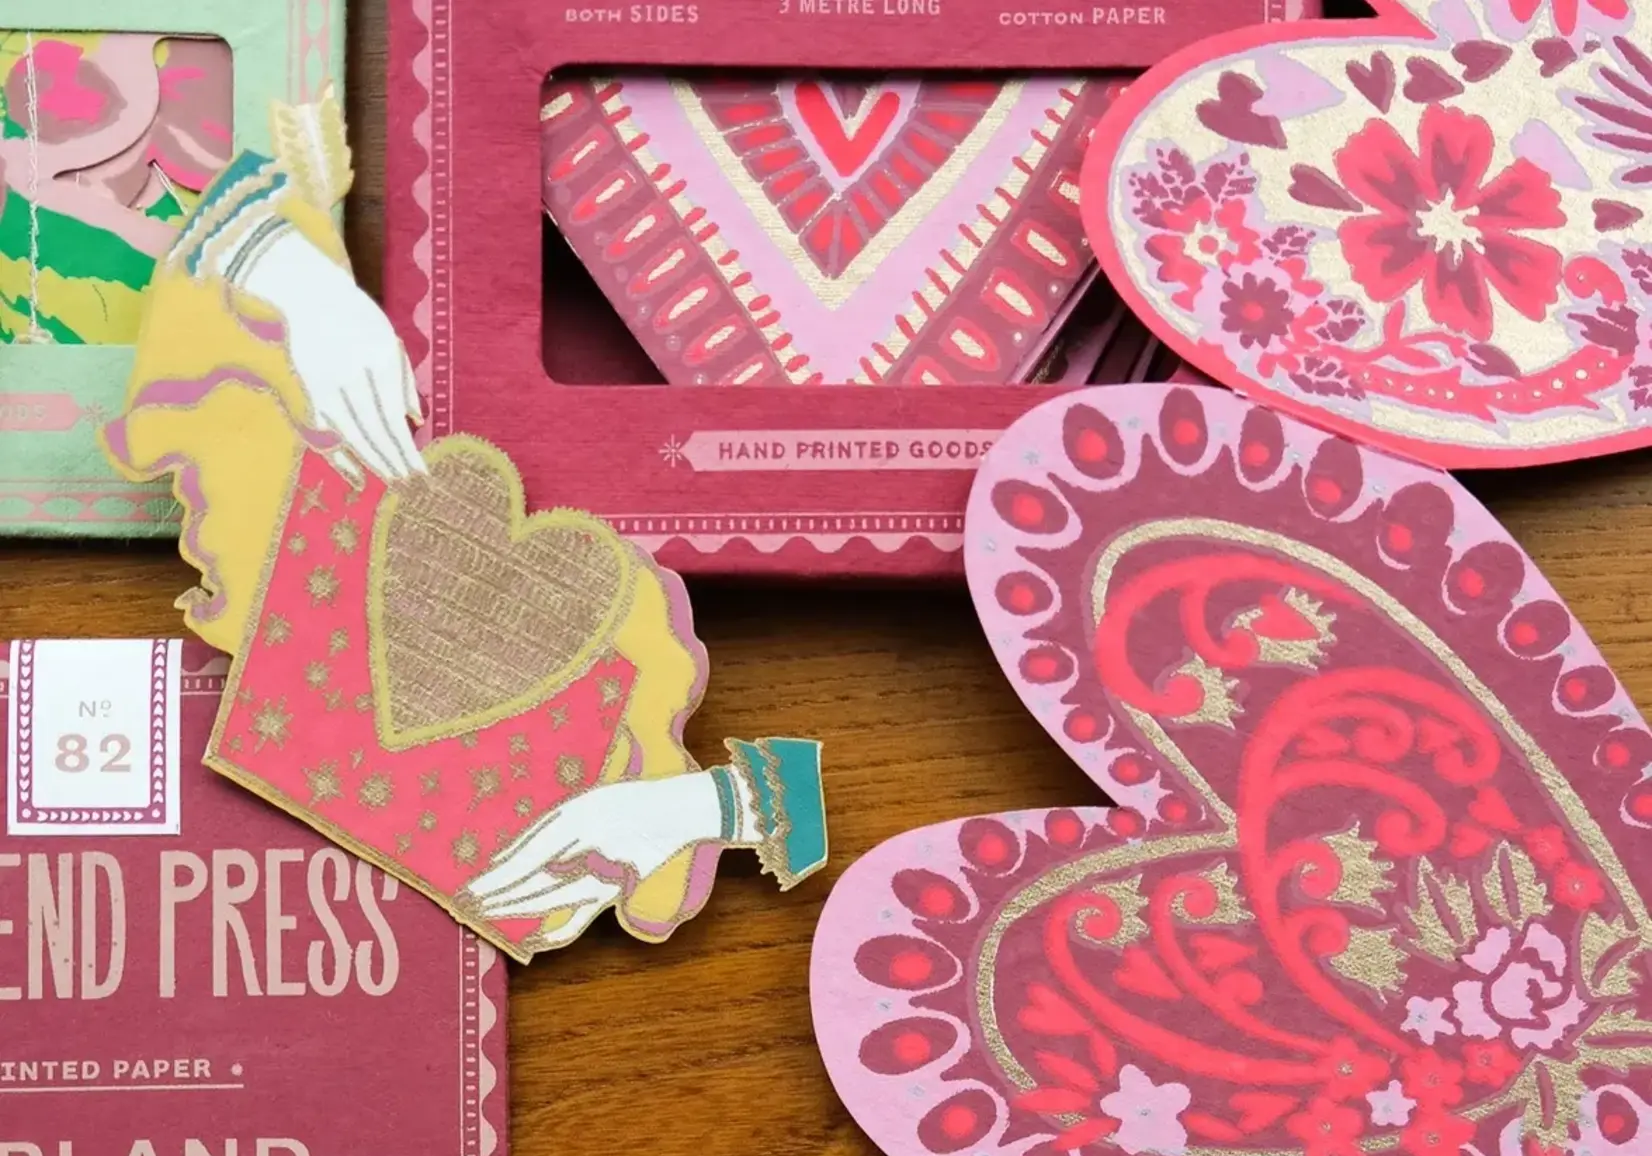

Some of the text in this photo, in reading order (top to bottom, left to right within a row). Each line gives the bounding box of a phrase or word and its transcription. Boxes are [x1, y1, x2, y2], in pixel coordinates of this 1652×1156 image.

[565, 5, 699, 23] BOTH SIDES
[779, 0, 941, 15] 3 METRE LONG
[999, 7, 1166, 25] COTTON PAPER
[718, 440, 994, 460] HAND PRINTED GOODS
[54, 734, 131, 773] 82
[159, 847, 400, 998] PRESS
[113, 1058, 211, 1079] PAPER
